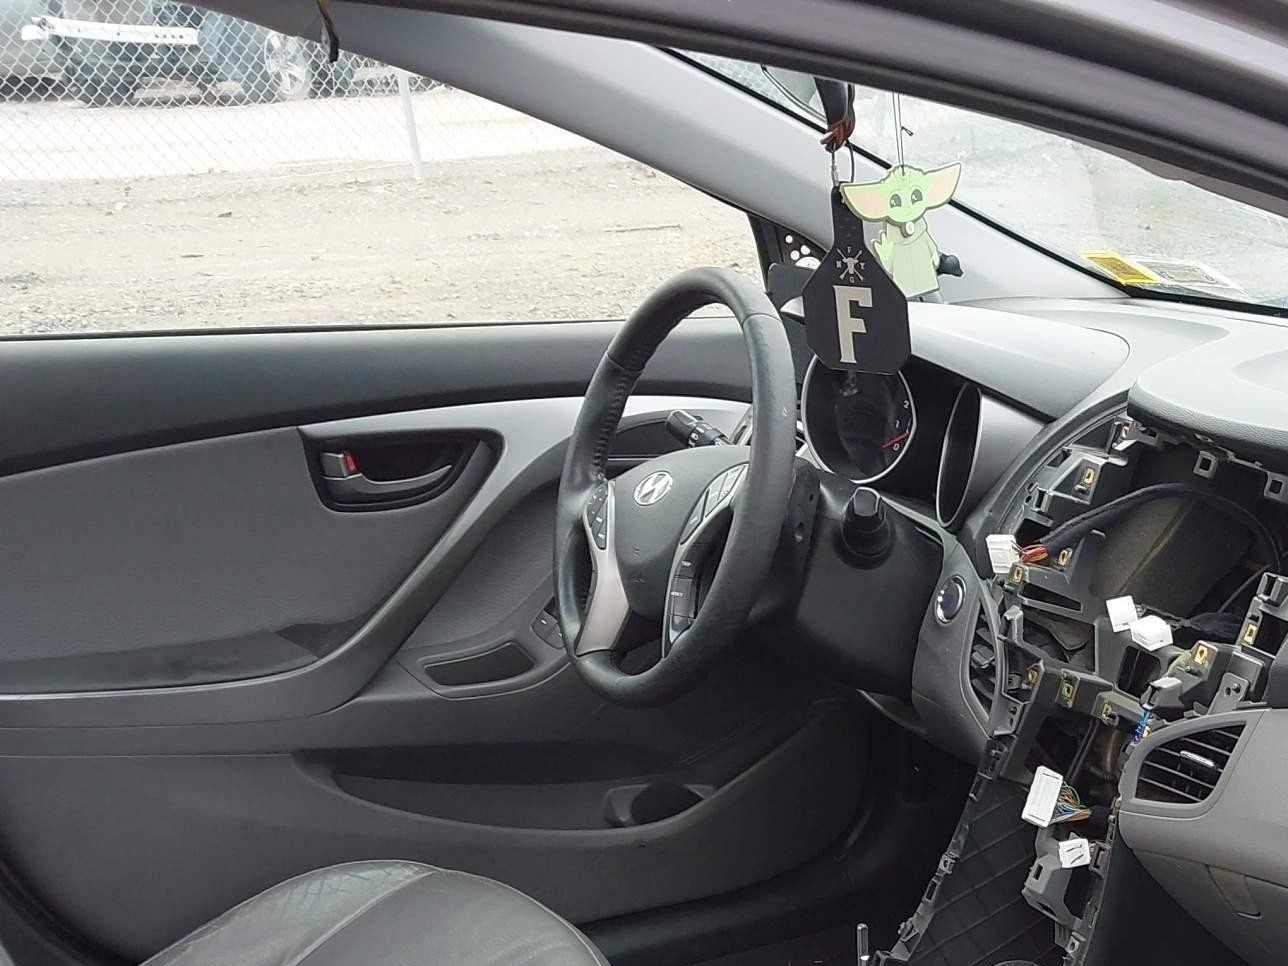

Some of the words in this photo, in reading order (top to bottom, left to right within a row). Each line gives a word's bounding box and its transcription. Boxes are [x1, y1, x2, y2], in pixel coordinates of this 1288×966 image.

[832, 285, 873, 364] F
[903, 400, 910, 409] 2
[893, 443, 900, 451] 0
